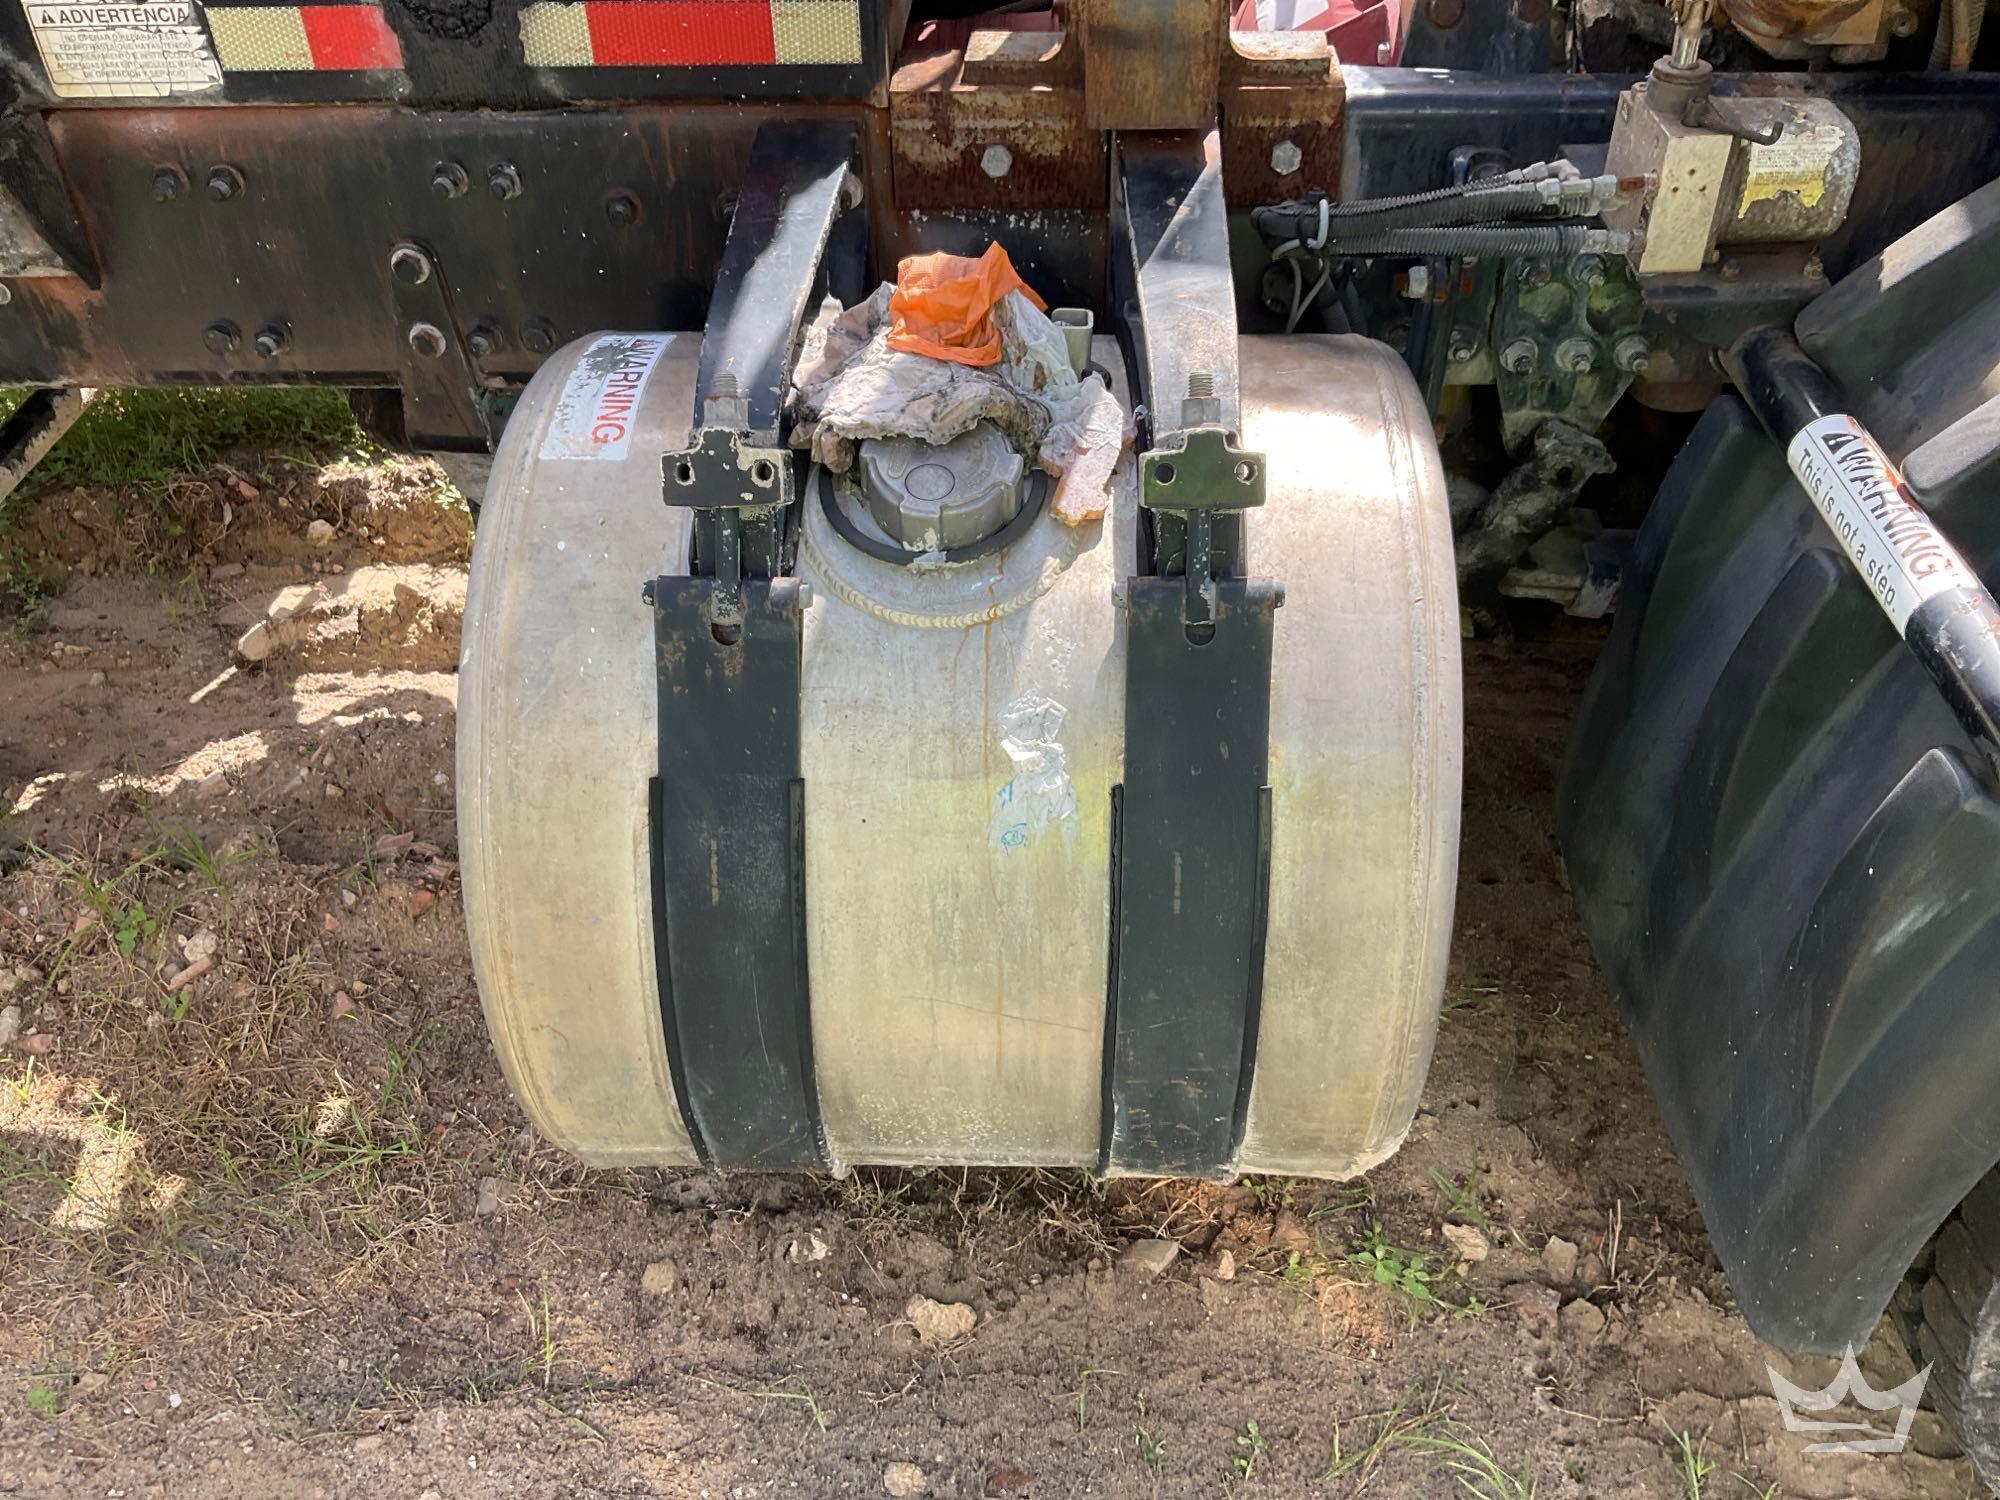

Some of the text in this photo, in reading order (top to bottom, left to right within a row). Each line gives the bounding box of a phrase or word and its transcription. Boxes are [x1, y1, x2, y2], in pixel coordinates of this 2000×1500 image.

[59, 8, 187, 24] ADVERTENCIA
[591, 344, 658, 444] WARNING
[1798, 448, 1822, 493] This
[1822, 485, 1835, 514] is
[1835, 511, 1858, 543] not
[1856, 543, 1866, 561] a
[1837, 448, 1954, 581] WARNING
